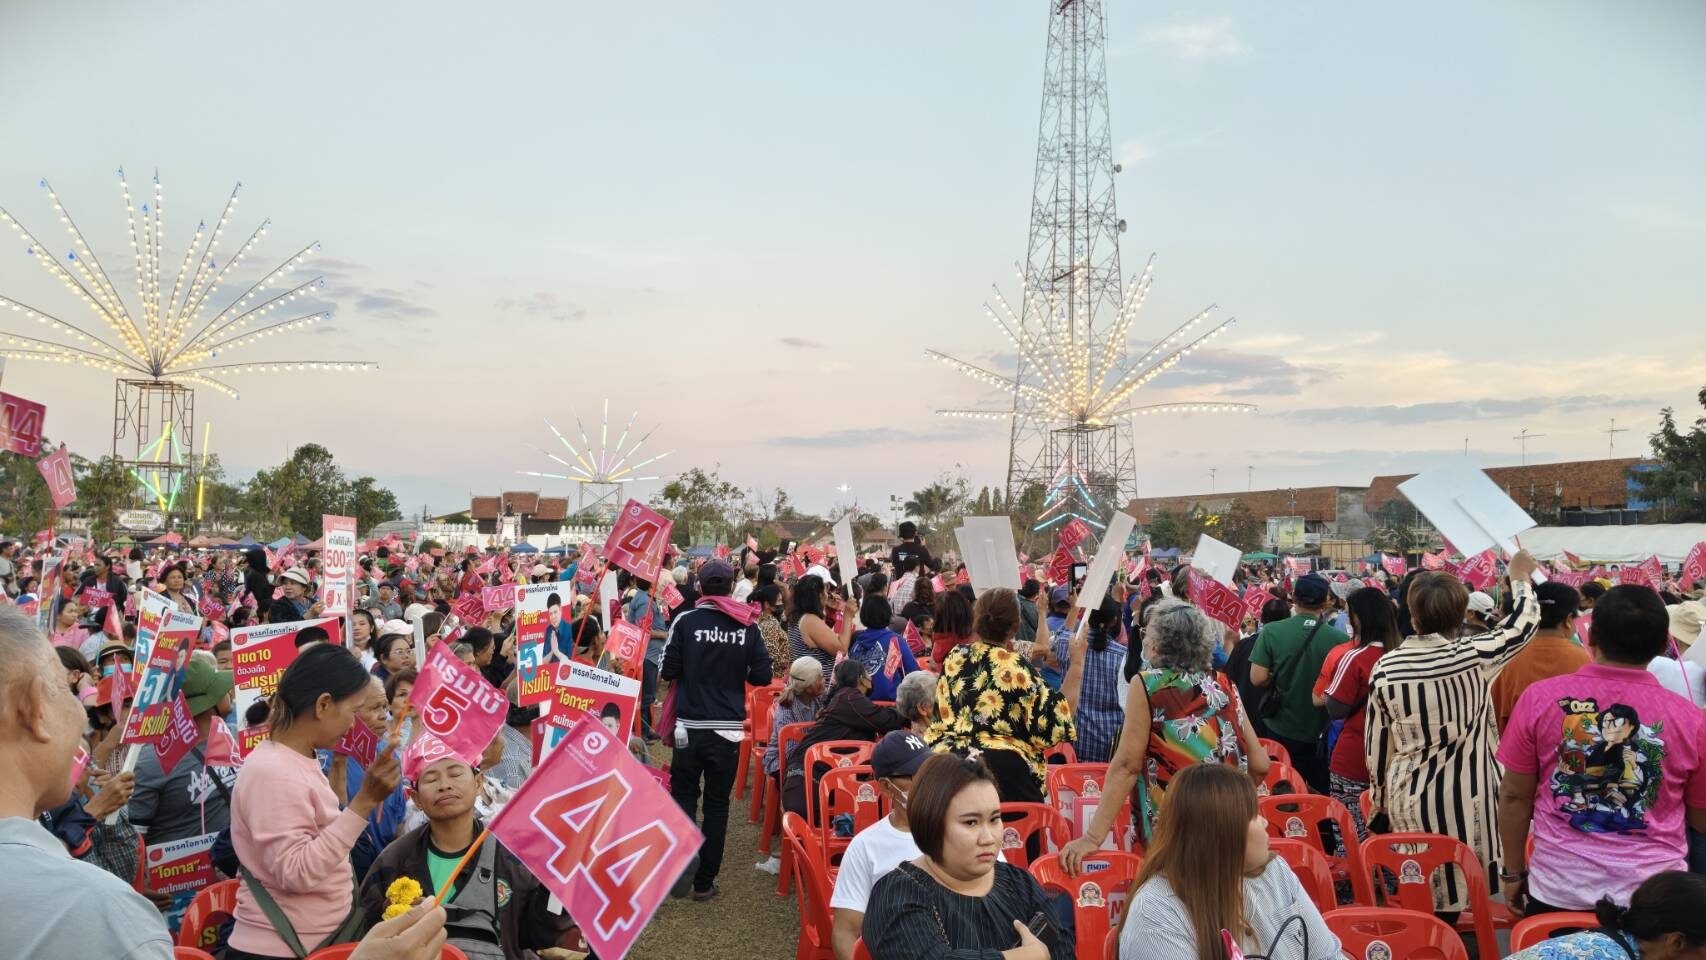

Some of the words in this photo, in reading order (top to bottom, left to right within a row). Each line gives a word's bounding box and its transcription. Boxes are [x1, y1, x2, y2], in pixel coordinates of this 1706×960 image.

[326, 549, 345, 568] 500
[458, 597, 487, 627] 44
[1206, 588, 1243, 628] 44
[619, 635, 638, 660] 5
[693, 626, 747, 646] ราชนาวี
[519, 641, 538, 681] 5
[572, 667, 621, 689] พรรคโอกาสใหม่
[432, 651, 504, 715] แรมโบ้
[422, 683, 471, 736] 5
[529, 768, 678, 942] 44
